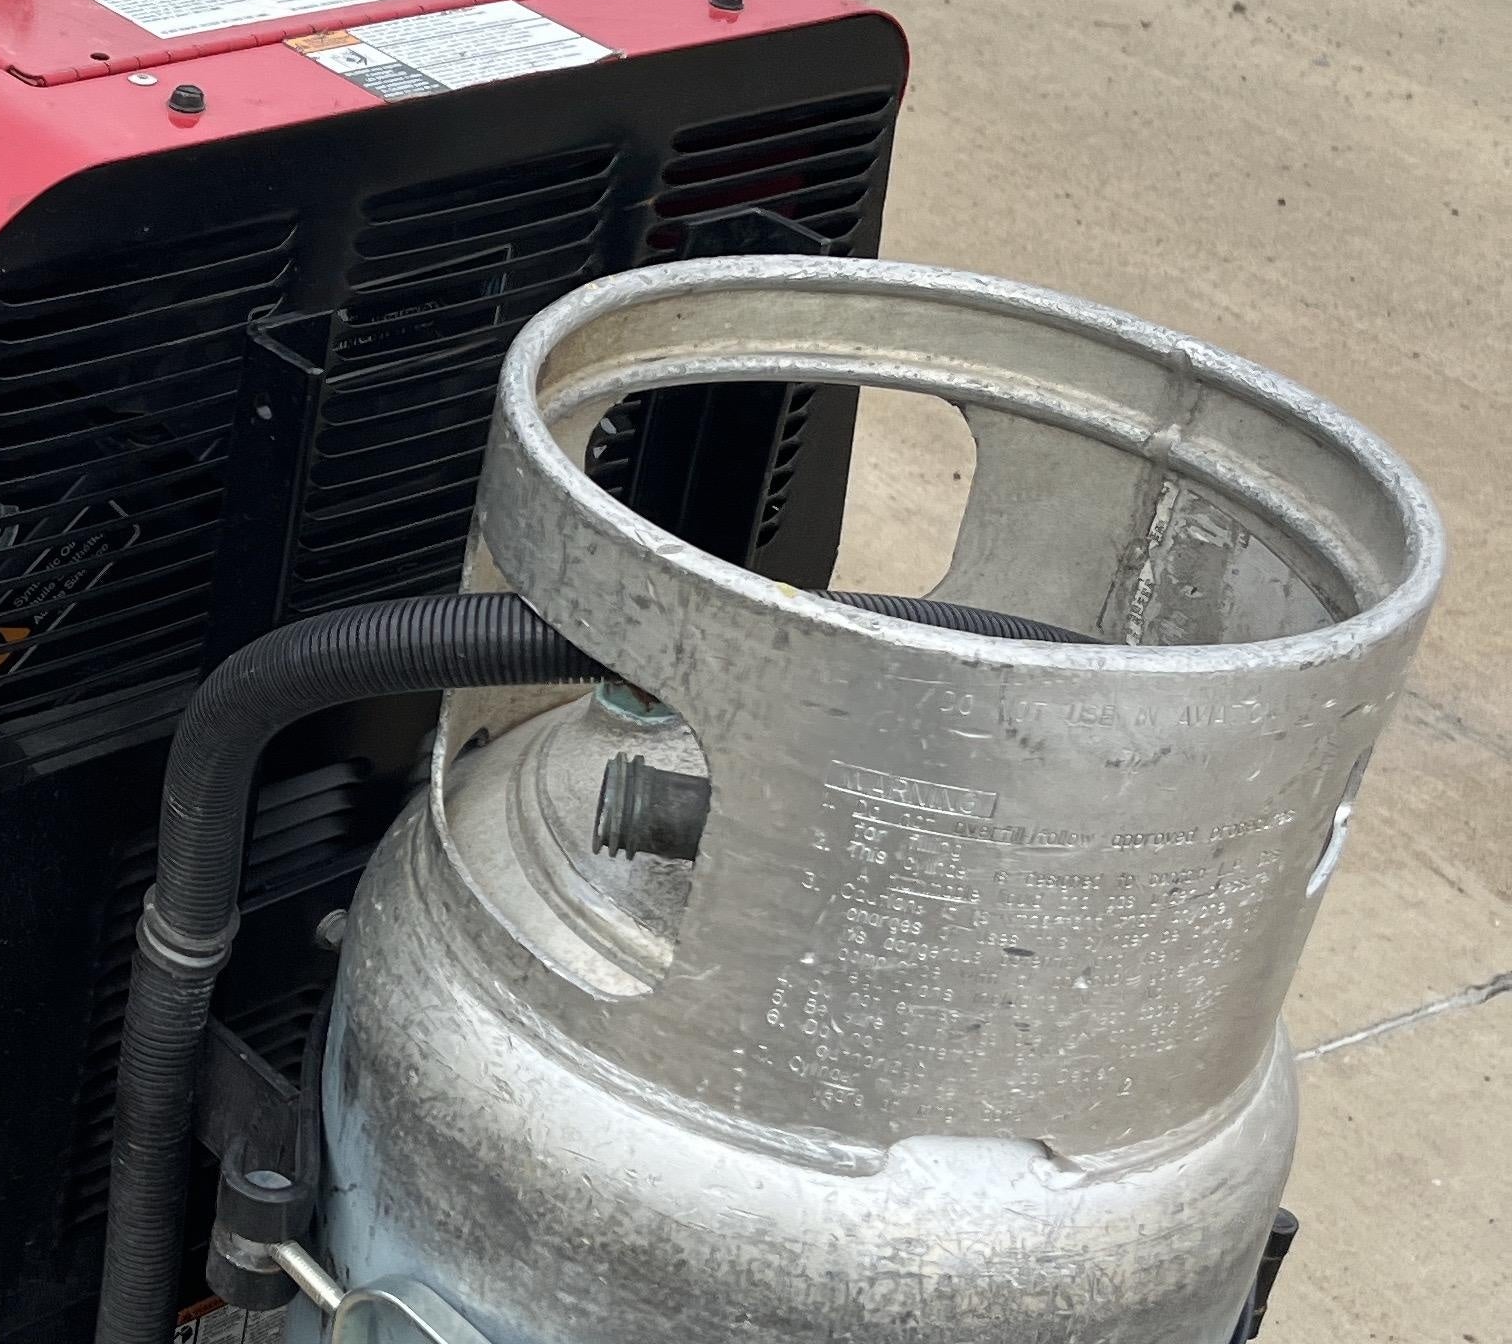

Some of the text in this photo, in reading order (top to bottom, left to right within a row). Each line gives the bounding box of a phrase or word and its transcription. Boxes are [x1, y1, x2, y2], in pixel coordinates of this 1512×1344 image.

[846, 840, 888, 865] This
[1111, 826, 1199, 853] approved
[845, 907, 924, 936] charges
[804, 997, 829, 1017] Be
